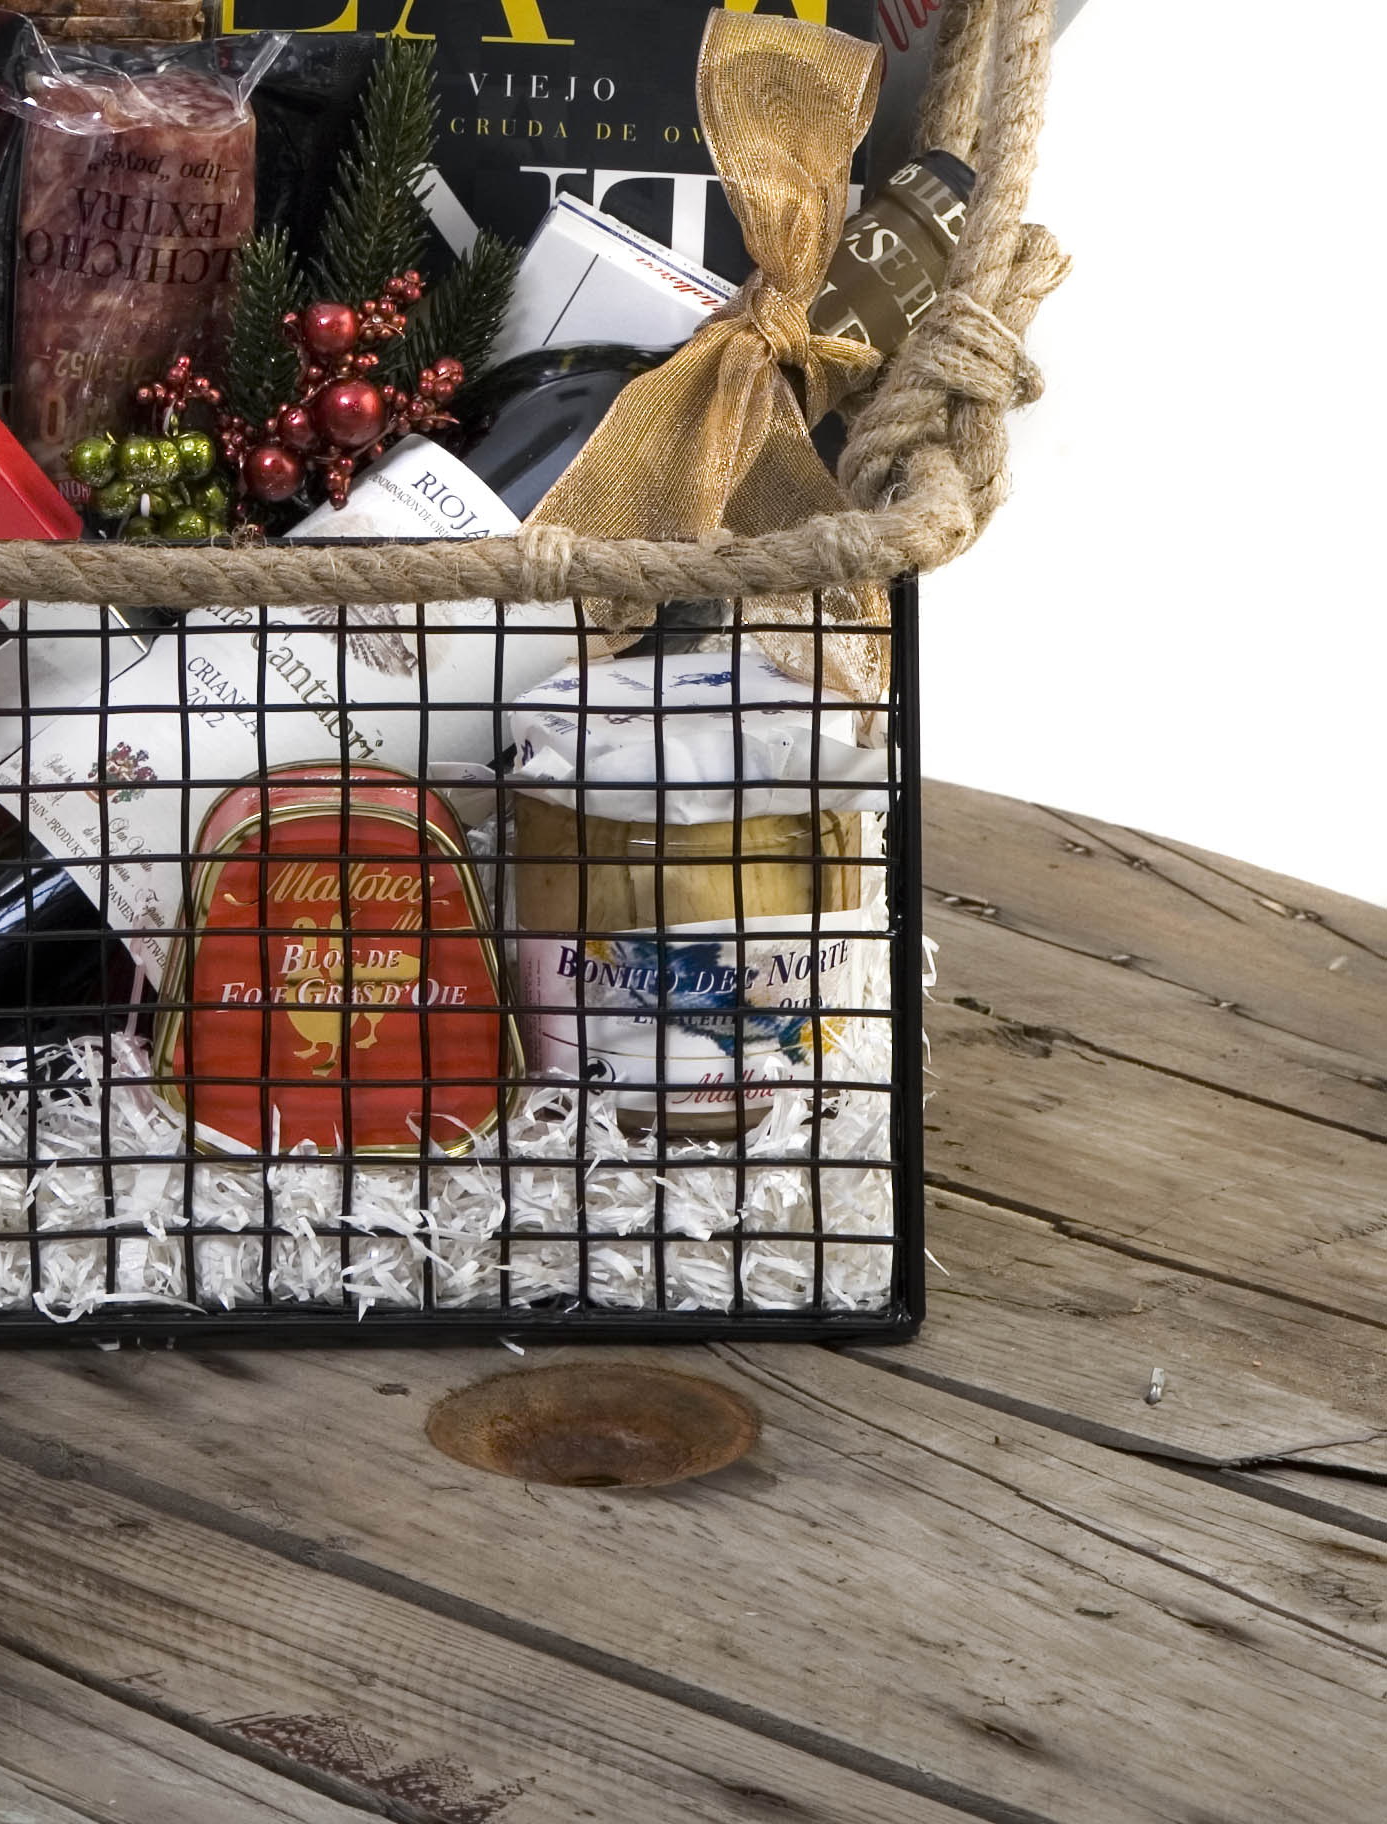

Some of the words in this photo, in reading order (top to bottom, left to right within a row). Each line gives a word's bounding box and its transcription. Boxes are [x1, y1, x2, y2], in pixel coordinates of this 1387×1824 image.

[468, 72, 616, 102] VIEJO
[451, 116, 569, 139] CRUDA
[596, 120, 637, 144] DE
[72, 186, 225, 239] EXTRA
[411, 471, 491, 540] RIOJA
[362, 949, 403, 970] DE
[556, 946, 679, 994] BONITO
[689, 966, 760, 994] DEL
[766, 938, 849, 988] NORTE
[297, 978, 376, 1006] GRAS
